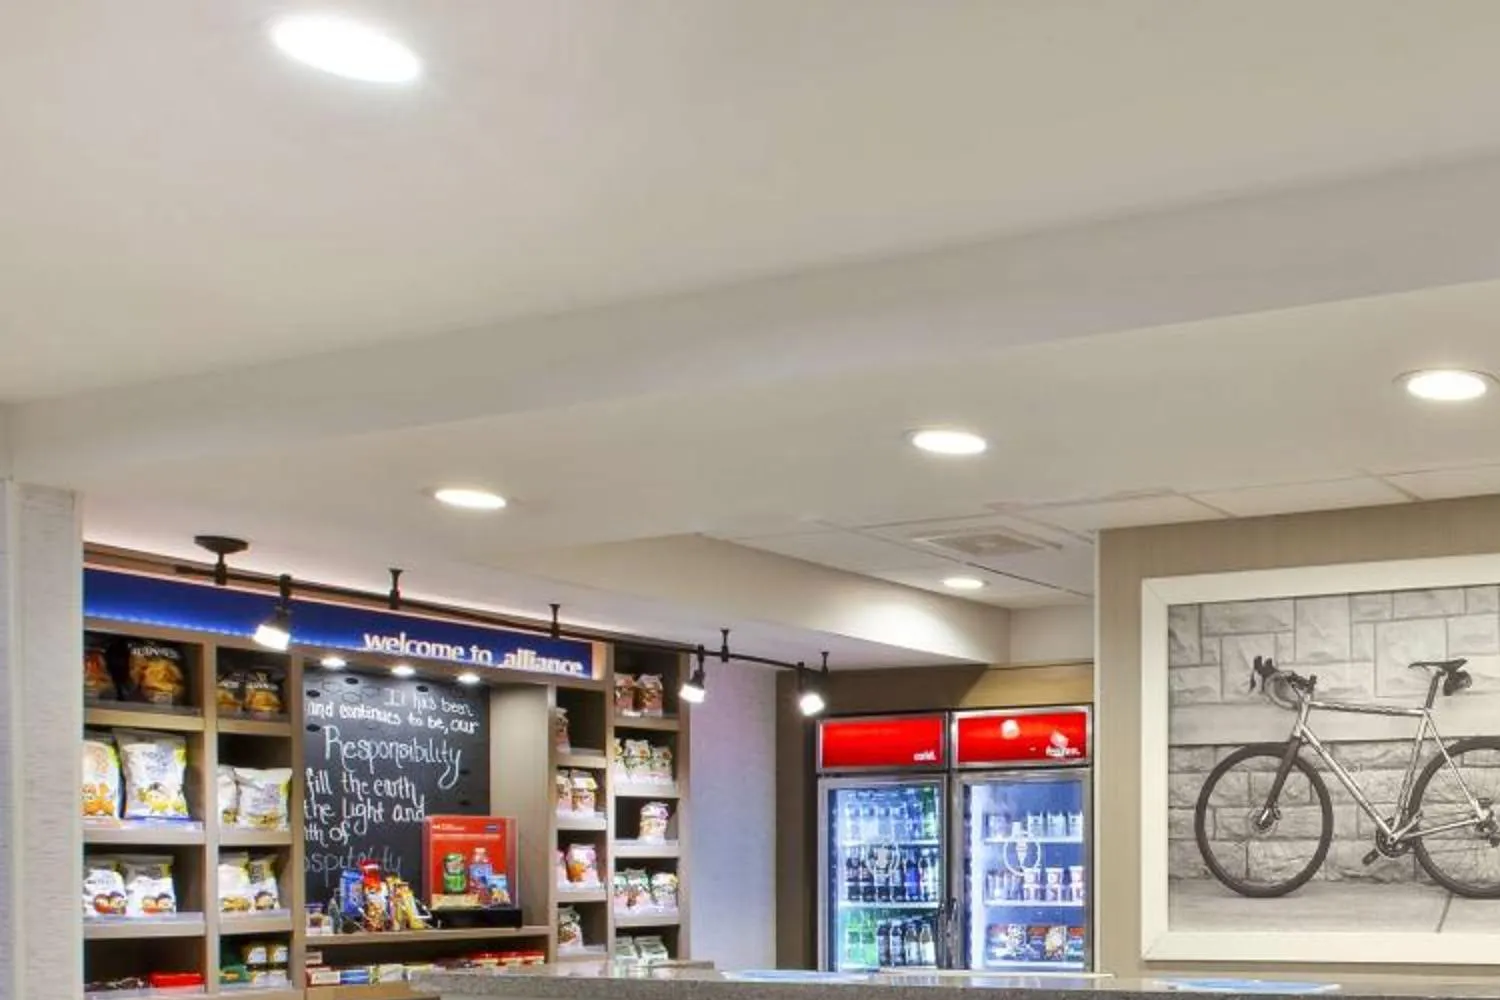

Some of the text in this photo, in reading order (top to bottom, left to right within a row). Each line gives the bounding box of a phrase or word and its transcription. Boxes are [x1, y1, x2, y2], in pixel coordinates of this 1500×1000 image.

[364, 632, 583, 677] welcome to alliance
[339, 704, 401, 725] continues
[407, 712, 424, 727] to
[450, 719, 479, 734] our
[323, 725, 463, 790] Responsibility
[305, 767, 333, 801] fill
[341, 772, 370, 802] the
[393, 795, 425, 823] and
[329, 820, 350, 846] of
